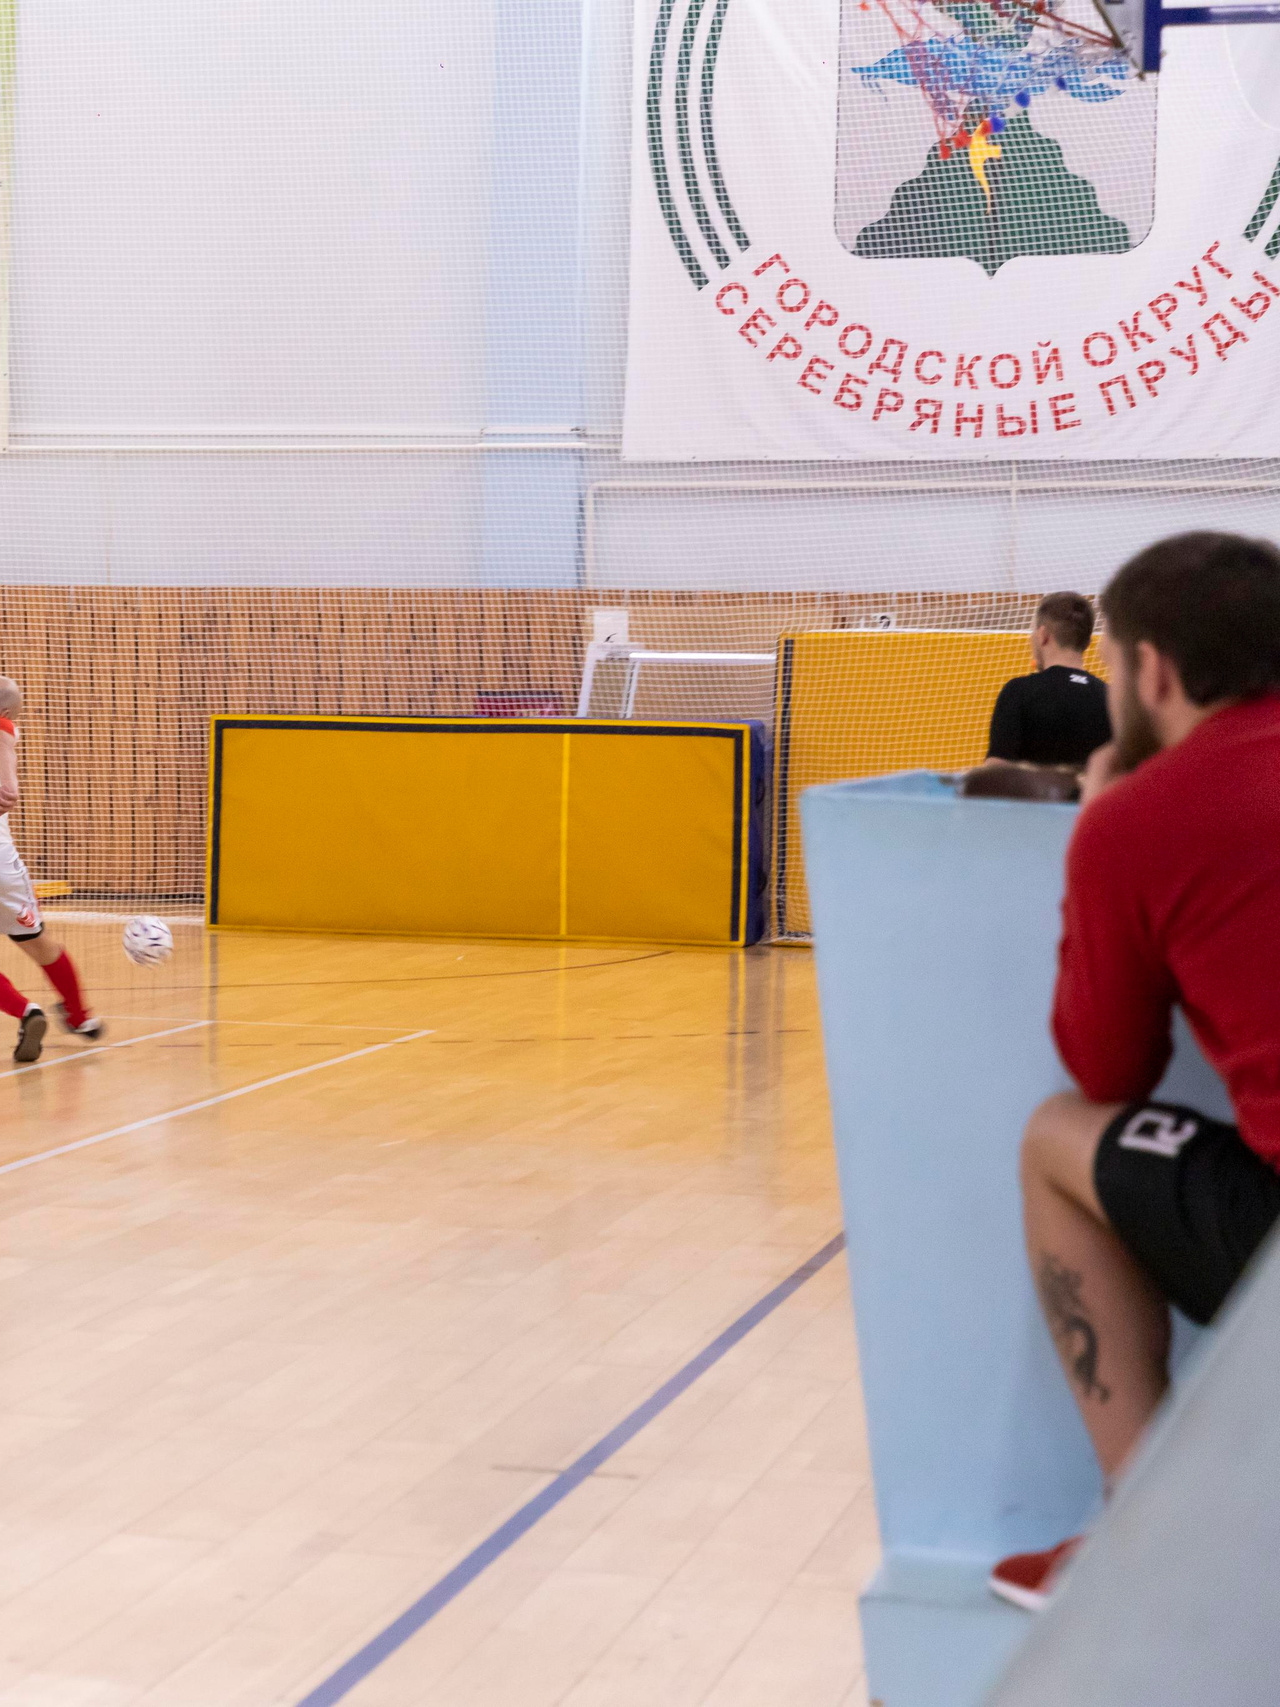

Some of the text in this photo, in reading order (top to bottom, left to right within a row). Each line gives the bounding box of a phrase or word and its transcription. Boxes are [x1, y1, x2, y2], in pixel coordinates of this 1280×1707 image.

[715, 271, 1280, 439] СЕРЕБРЯНЫЕ ПРУДЫ
[752, 241, 1233, 390] ГОРОДСКОЙ ОКРУГ
